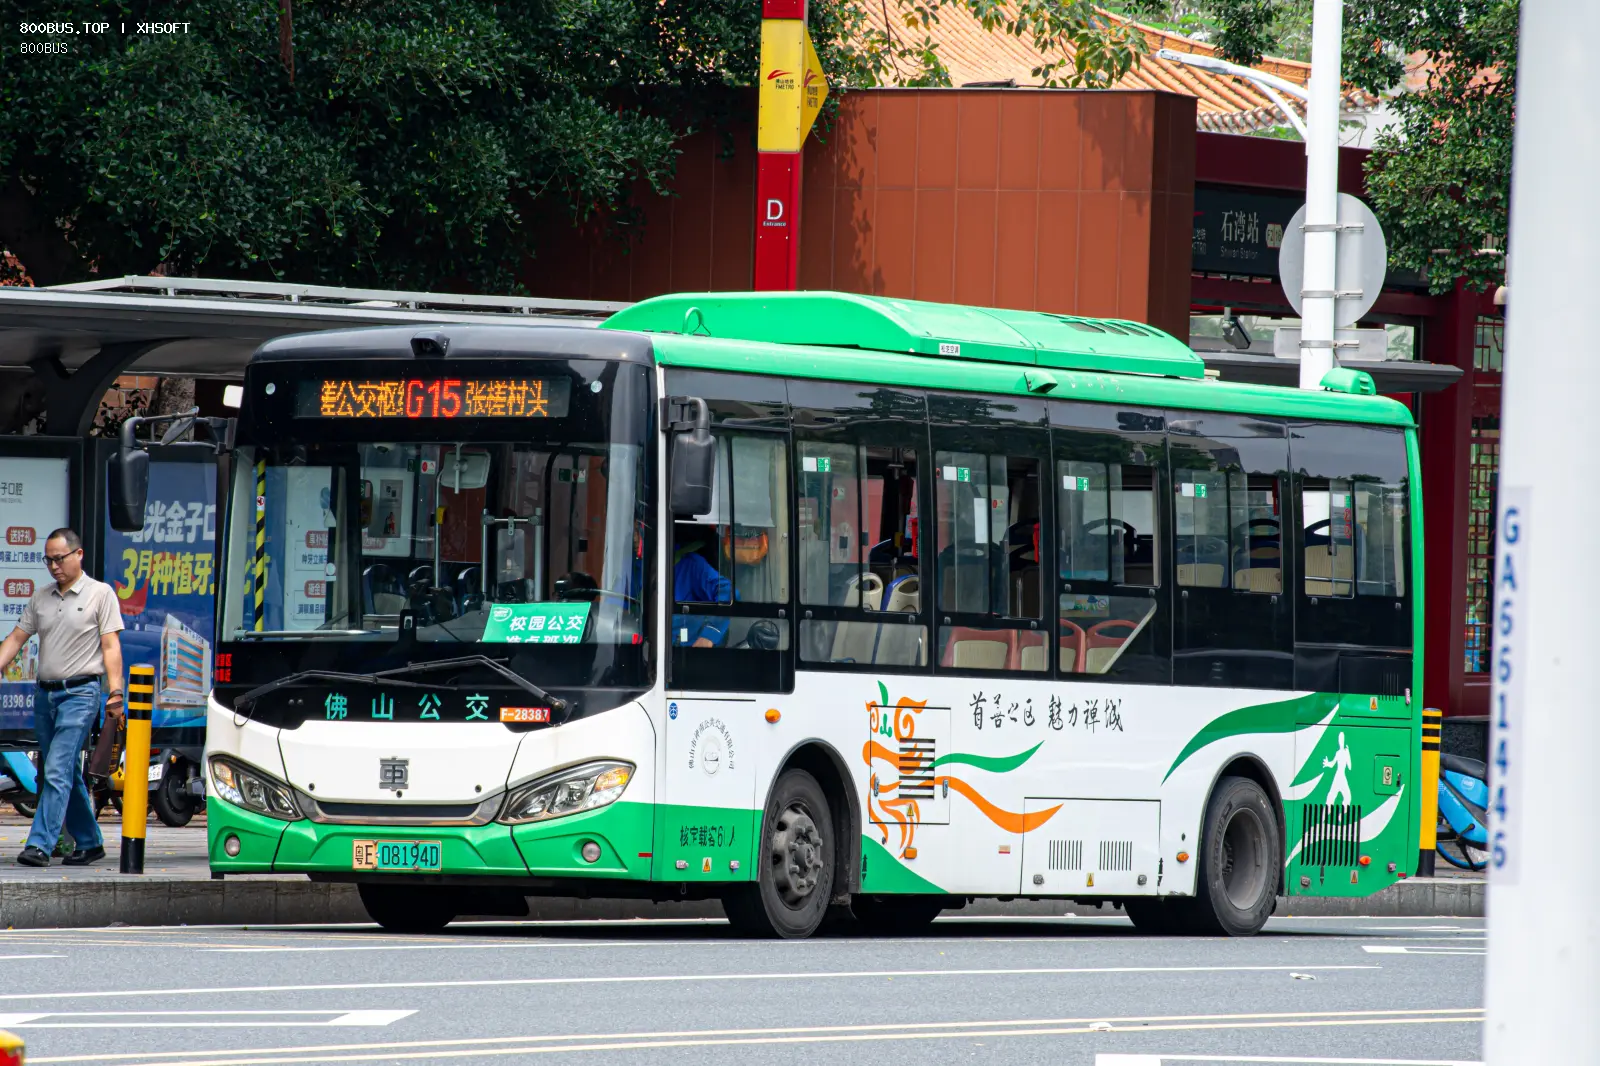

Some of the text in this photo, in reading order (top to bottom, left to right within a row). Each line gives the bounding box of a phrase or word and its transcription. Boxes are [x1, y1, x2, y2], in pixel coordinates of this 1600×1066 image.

[767, 199, 783, 220] D
[1221, 210, 1259, 244] 石湾站
[406, 379, 462, 418] G15
[10, 529, 31, 543] 送好礼
[118, 548, 215, 600] 3月种植牙
[509, 615, 584, 632] 校园公交
[2, 694, 24, 709] 8398
[324, 692, 490, 722] 佛山公交
[501, 708, 549, 722] F-28387
[381, 845, 439, 867] 08194D
